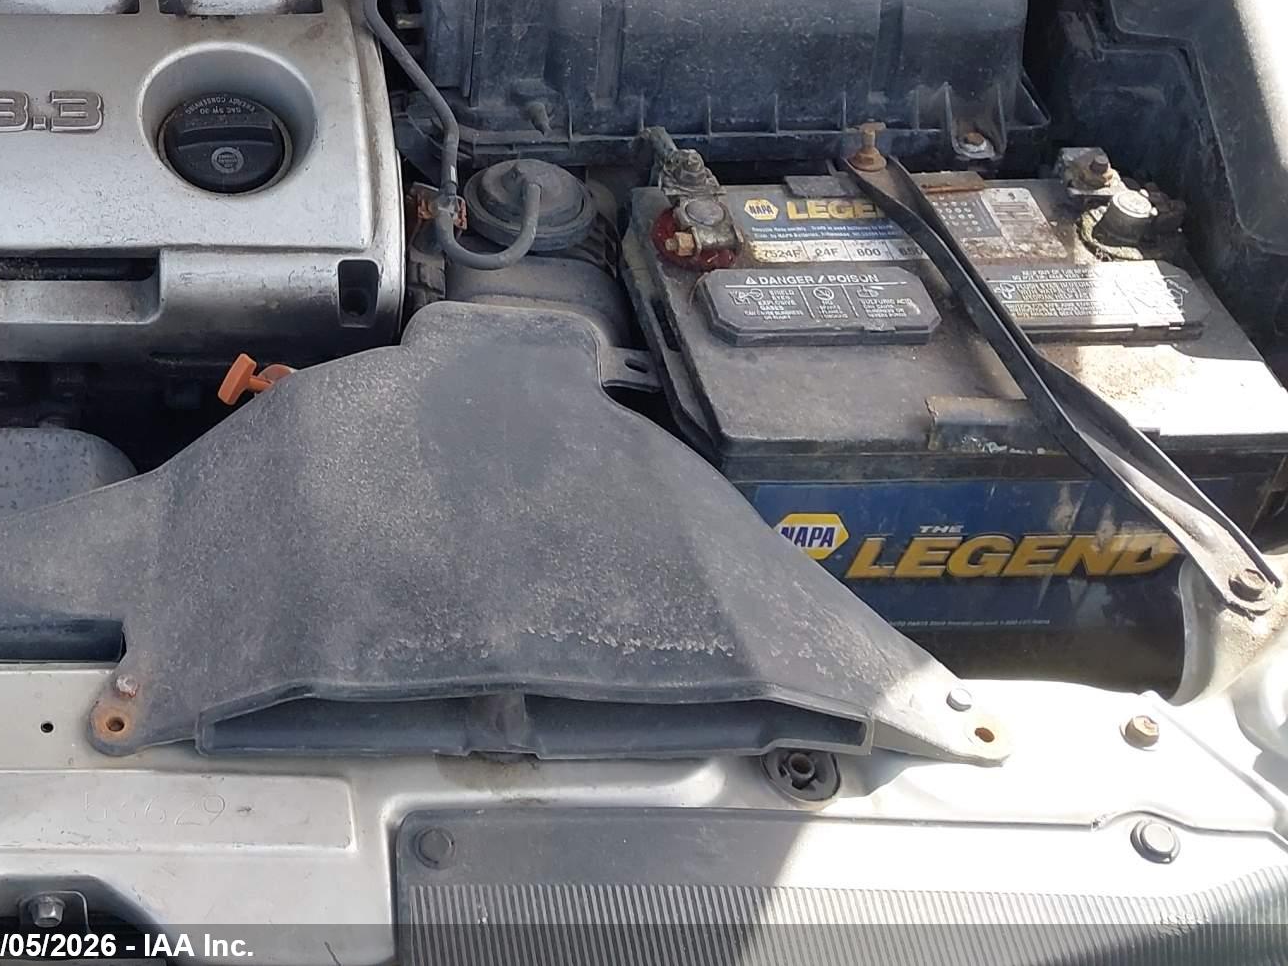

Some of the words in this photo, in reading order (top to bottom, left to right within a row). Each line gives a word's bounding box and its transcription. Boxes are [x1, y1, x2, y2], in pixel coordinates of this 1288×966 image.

[748, 205, 774, 215] NAPA
[759, 275, 814, 284] DANGER
[828, 274, 880, 283] POISON
[919, 524, 964, 533] THE
[780, 525, 835, 549] NAPA
[844, 534, 1187, 579] LEGEND
